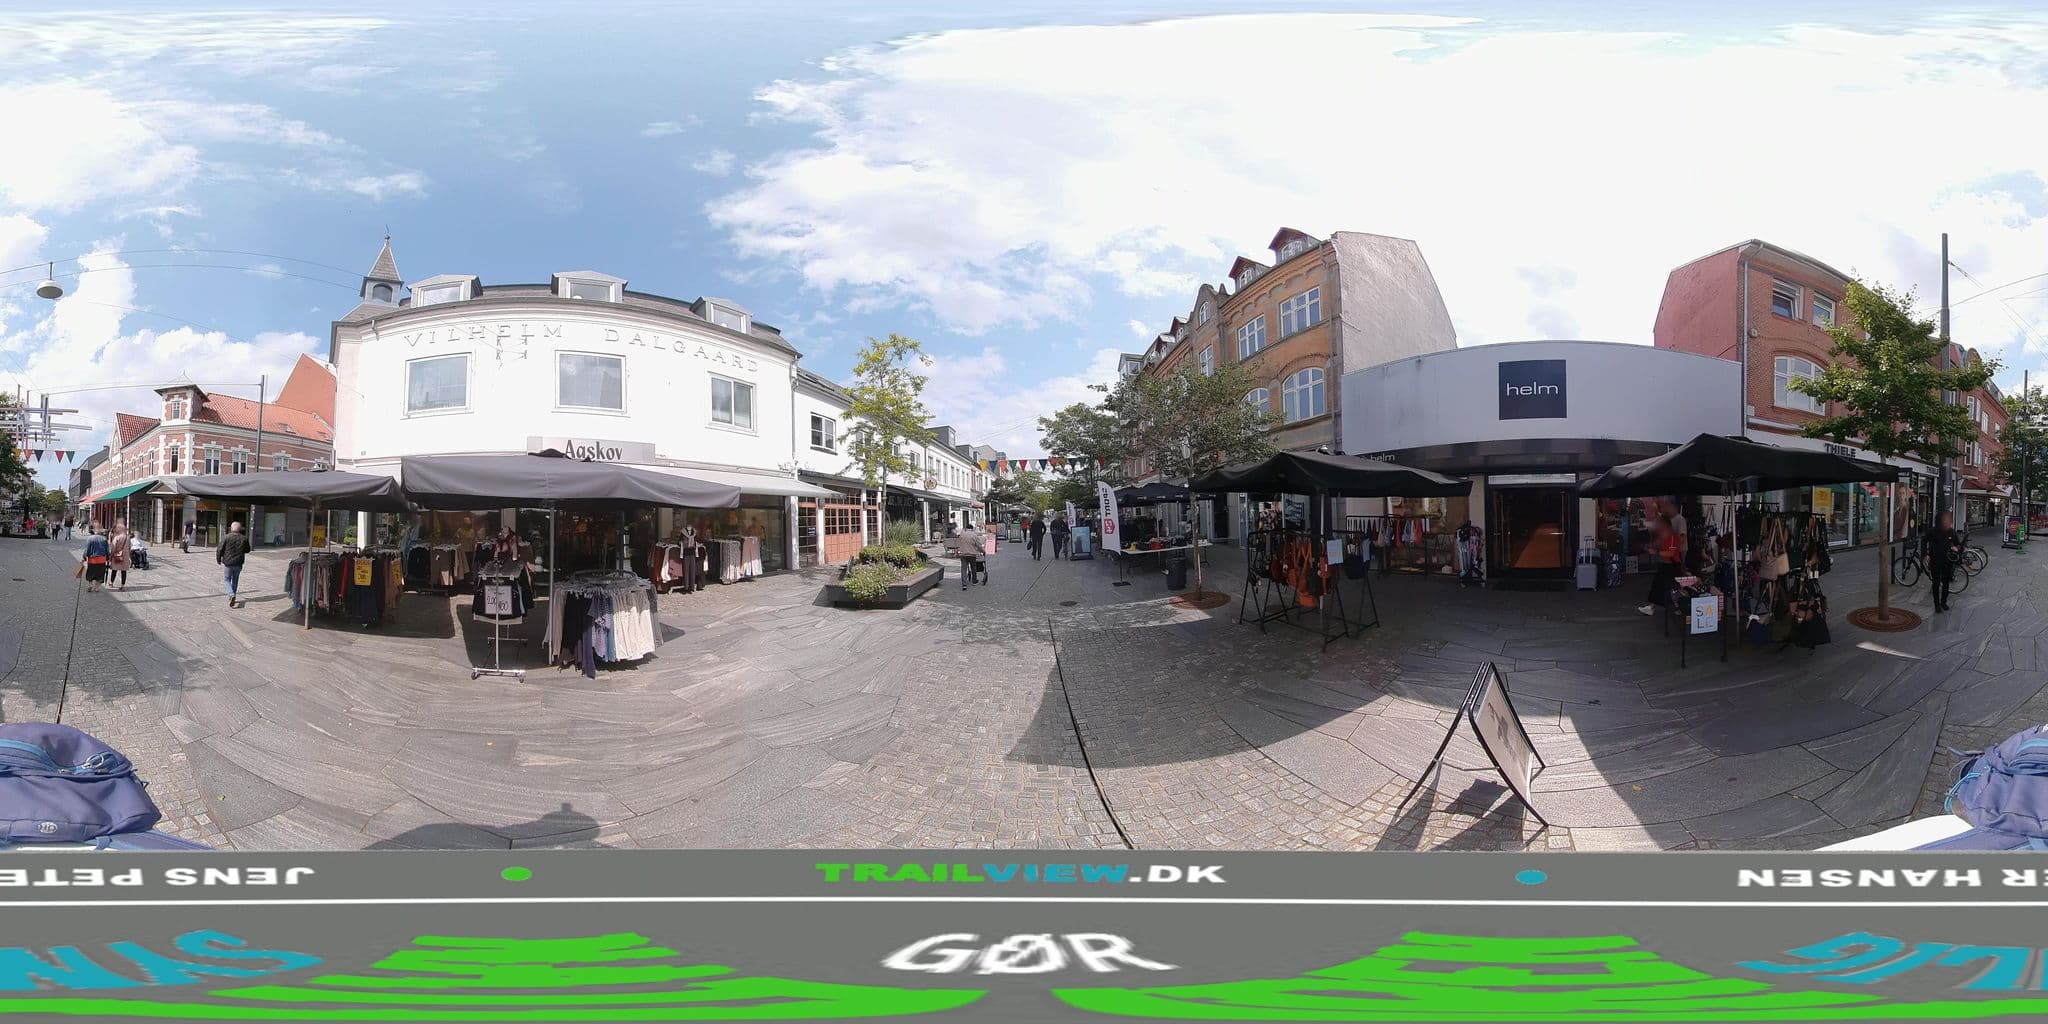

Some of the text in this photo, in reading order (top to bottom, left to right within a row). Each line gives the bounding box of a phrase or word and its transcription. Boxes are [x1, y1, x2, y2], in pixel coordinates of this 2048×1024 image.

[404, 324, 758, 372] VILHELM DALGAARD
[1506, 381, 1558, 396] helm
[565, 439, 622, 461] Aaskov
[1370, 453, 1396, 463] helm
[1824, 442, 1856, 458] THIELE
